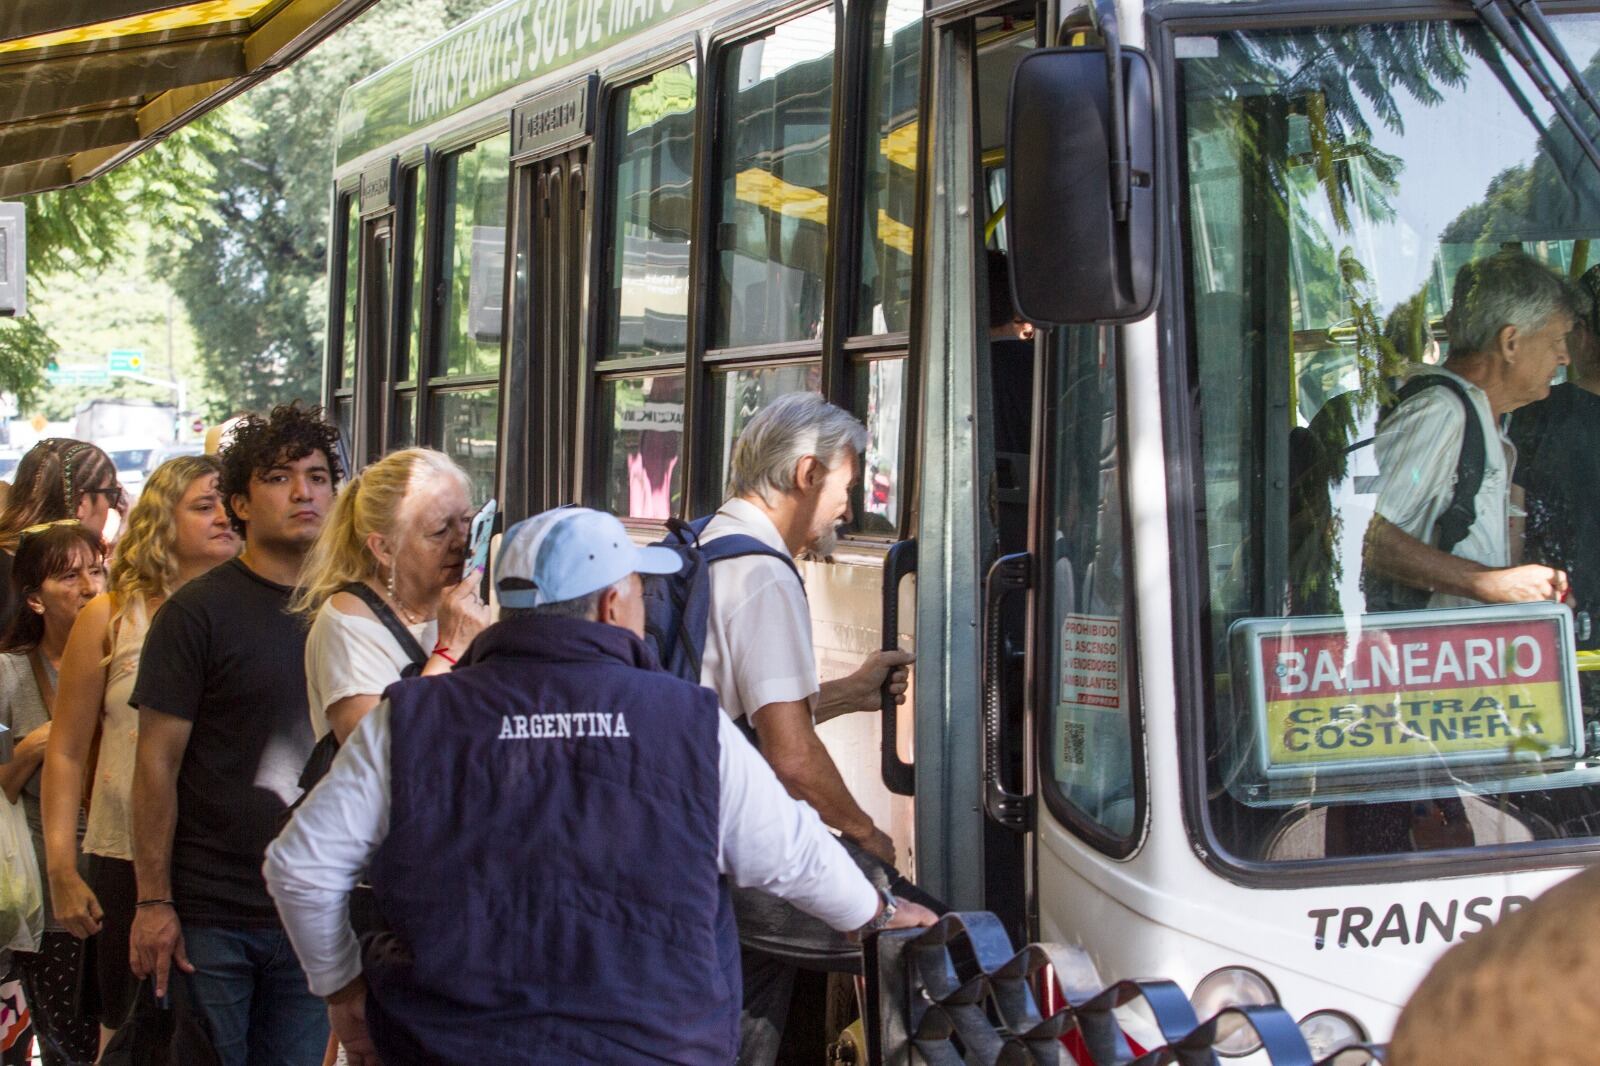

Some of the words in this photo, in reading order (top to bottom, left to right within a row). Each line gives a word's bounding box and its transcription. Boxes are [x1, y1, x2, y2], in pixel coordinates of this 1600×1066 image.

[408, 0, 529, 124] TRANSPORTES
[528, 0, 569, 71] SOL
[1065, 622, 1117, 637] PROHIBIDO
[1064, 639, 1073, 651] EL
[1074, 640, 1117, 655] ASCENSO
[1070, 657, 1117, 673] VENDEDORES
[1279, 635, 1542, 694] BALNEARIO
[1064, 674, 1117, 690] AMBULANTES
[1289, 695, 1536, 724] CENTRAL
[498, 712, 631, 739] ARGENTINA
[1284, 713, 1544, 751] COSTANERA
